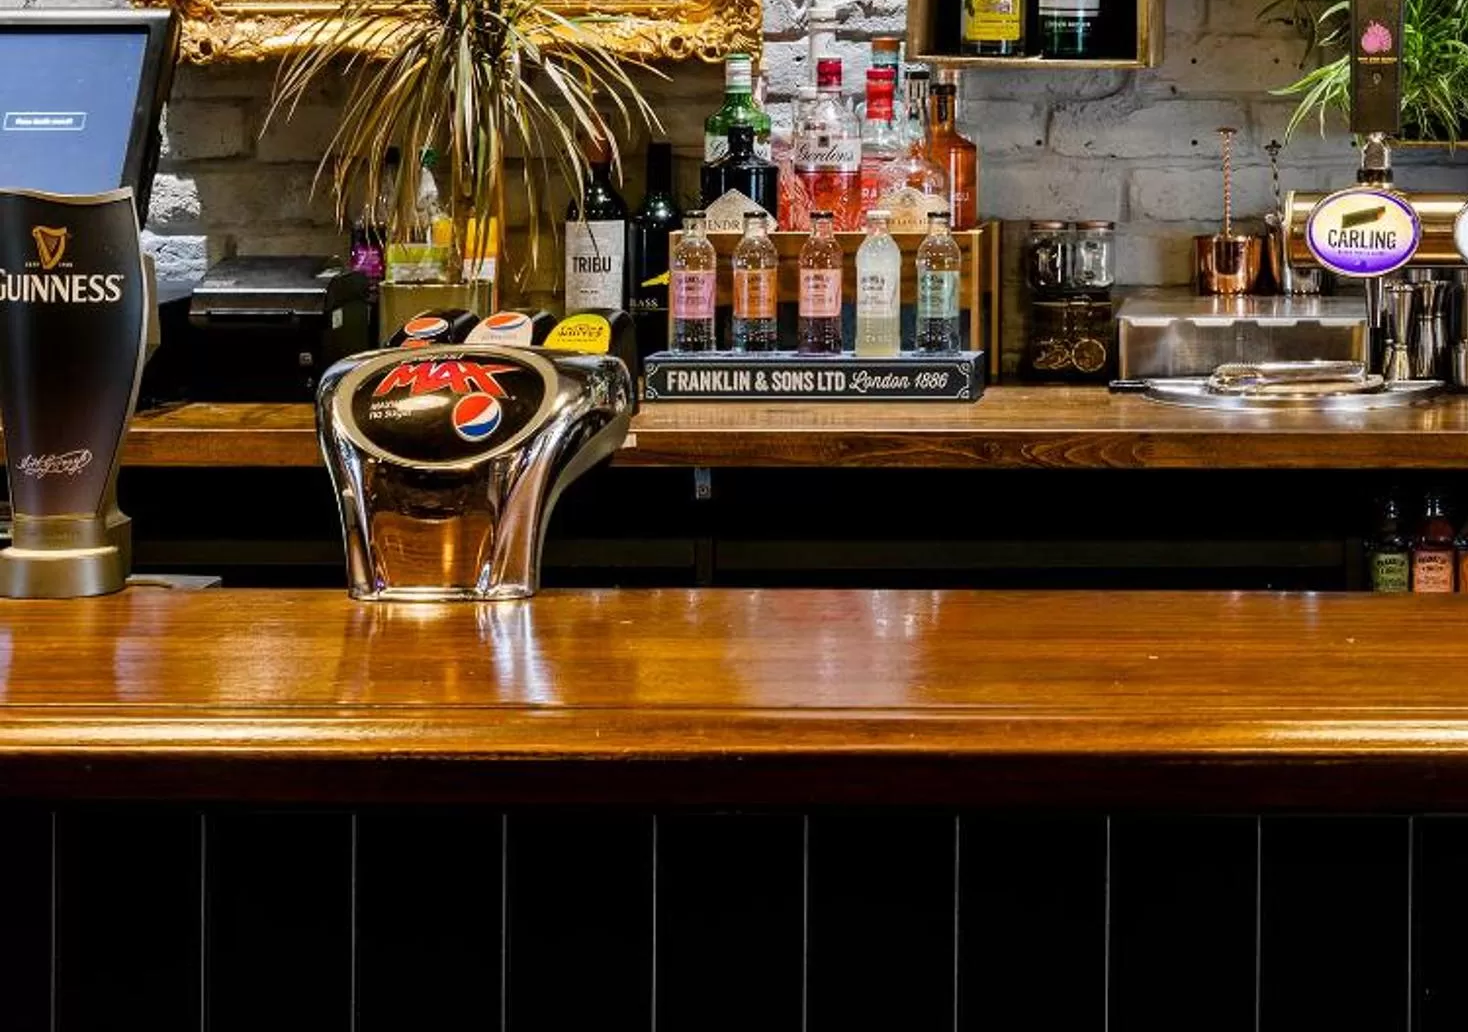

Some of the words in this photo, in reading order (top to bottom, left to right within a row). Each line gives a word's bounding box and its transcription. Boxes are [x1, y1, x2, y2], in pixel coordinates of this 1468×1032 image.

[1327, 229, 1397, 250] CARLING
[572, 256, 611, 274] TRIBU
[372, 360, 522, 399] MAX
[666, 370, 751, 392] FRANKLIN
[754, 370, 768, 392] &
[772, 371, 815, 392] SONS
[817, 371, 846, 391] LTD
[848, 370, 911, 394] London
[915, 371, 950, 390] 1886
